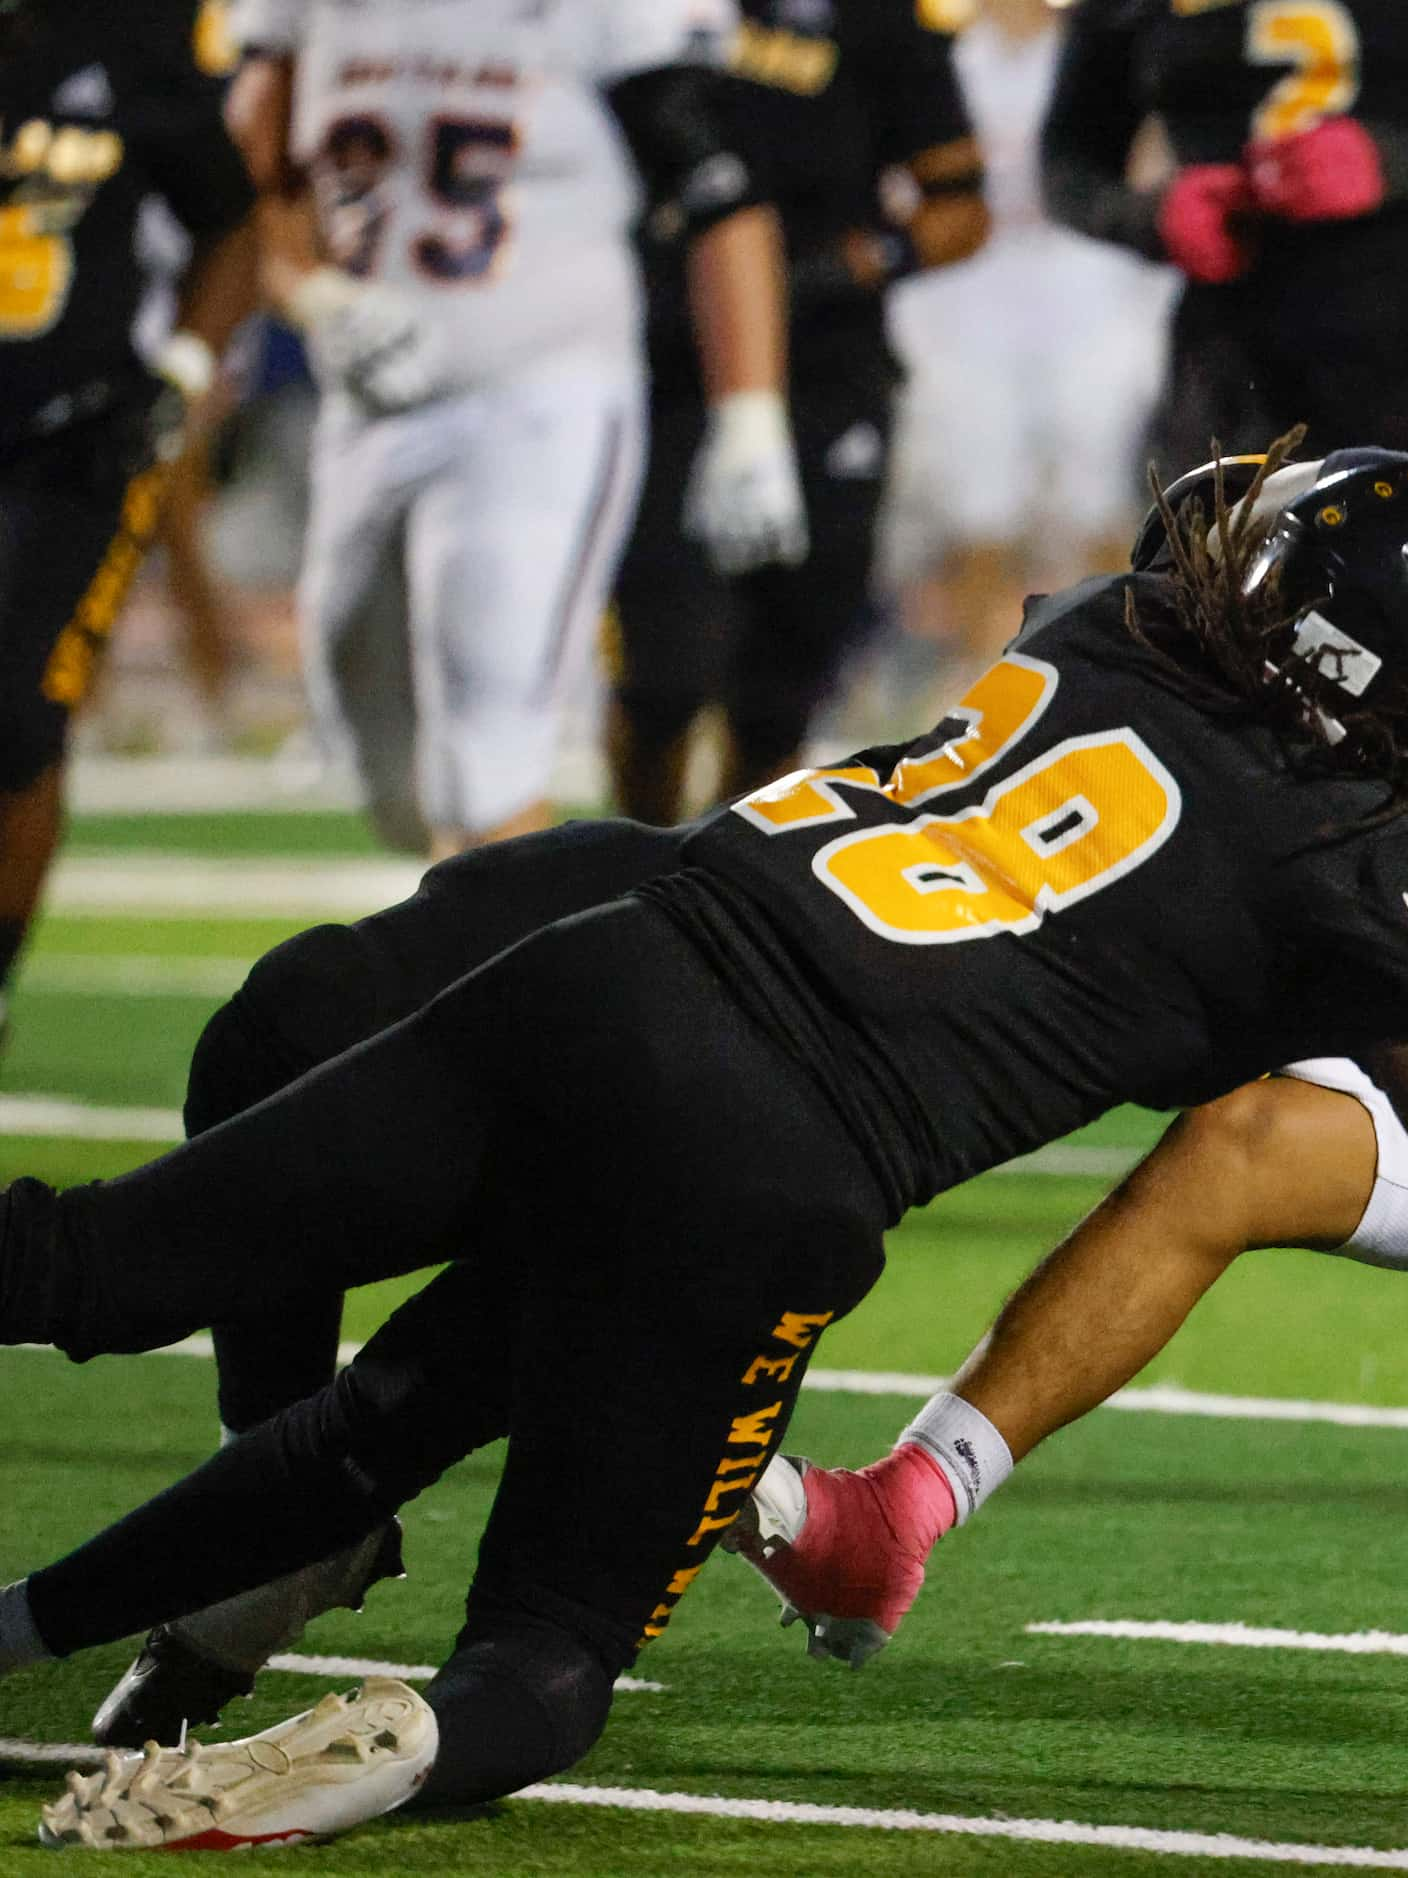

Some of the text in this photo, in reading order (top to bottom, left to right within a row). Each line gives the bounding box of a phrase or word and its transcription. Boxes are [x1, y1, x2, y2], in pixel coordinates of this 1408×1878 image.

[1246, 0, 1357, 143] 2
[730, 650, 1183, 946] 28
[740, 1310, 834, 1385] WE
